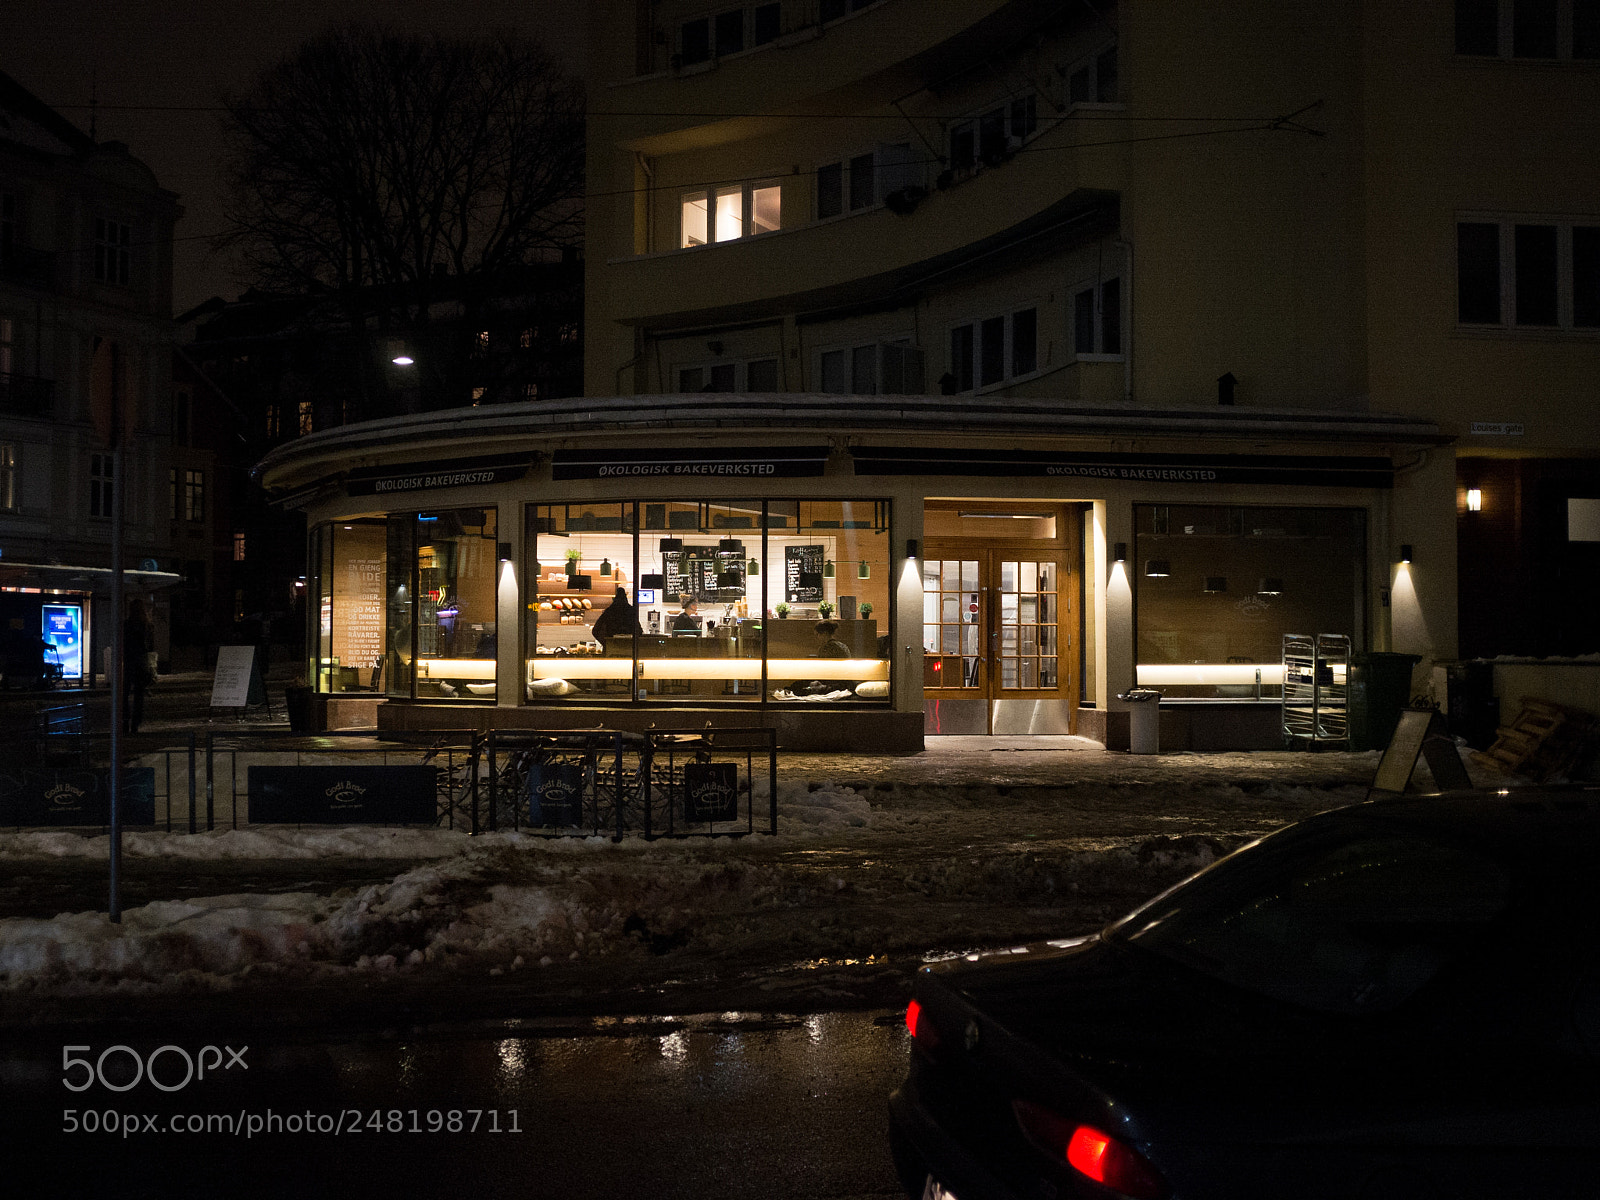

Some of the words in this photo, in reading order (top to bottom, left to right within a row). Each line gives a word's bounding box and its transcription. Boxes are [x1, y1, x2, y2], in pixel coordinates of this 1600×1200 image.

[599, 464, 670, 476] ØKOLOGISK
[674, 464, 775, 475] BAKEVERKSTED
[1046, 466, 1118, 478] ØKOLOGISK
[1120, 468, 1217, 480] BAKEVERKSTED
[375, 478, 423, 492] ØKOLOGISK
[424, 471, 495, 488] BAKEVERKSTED
